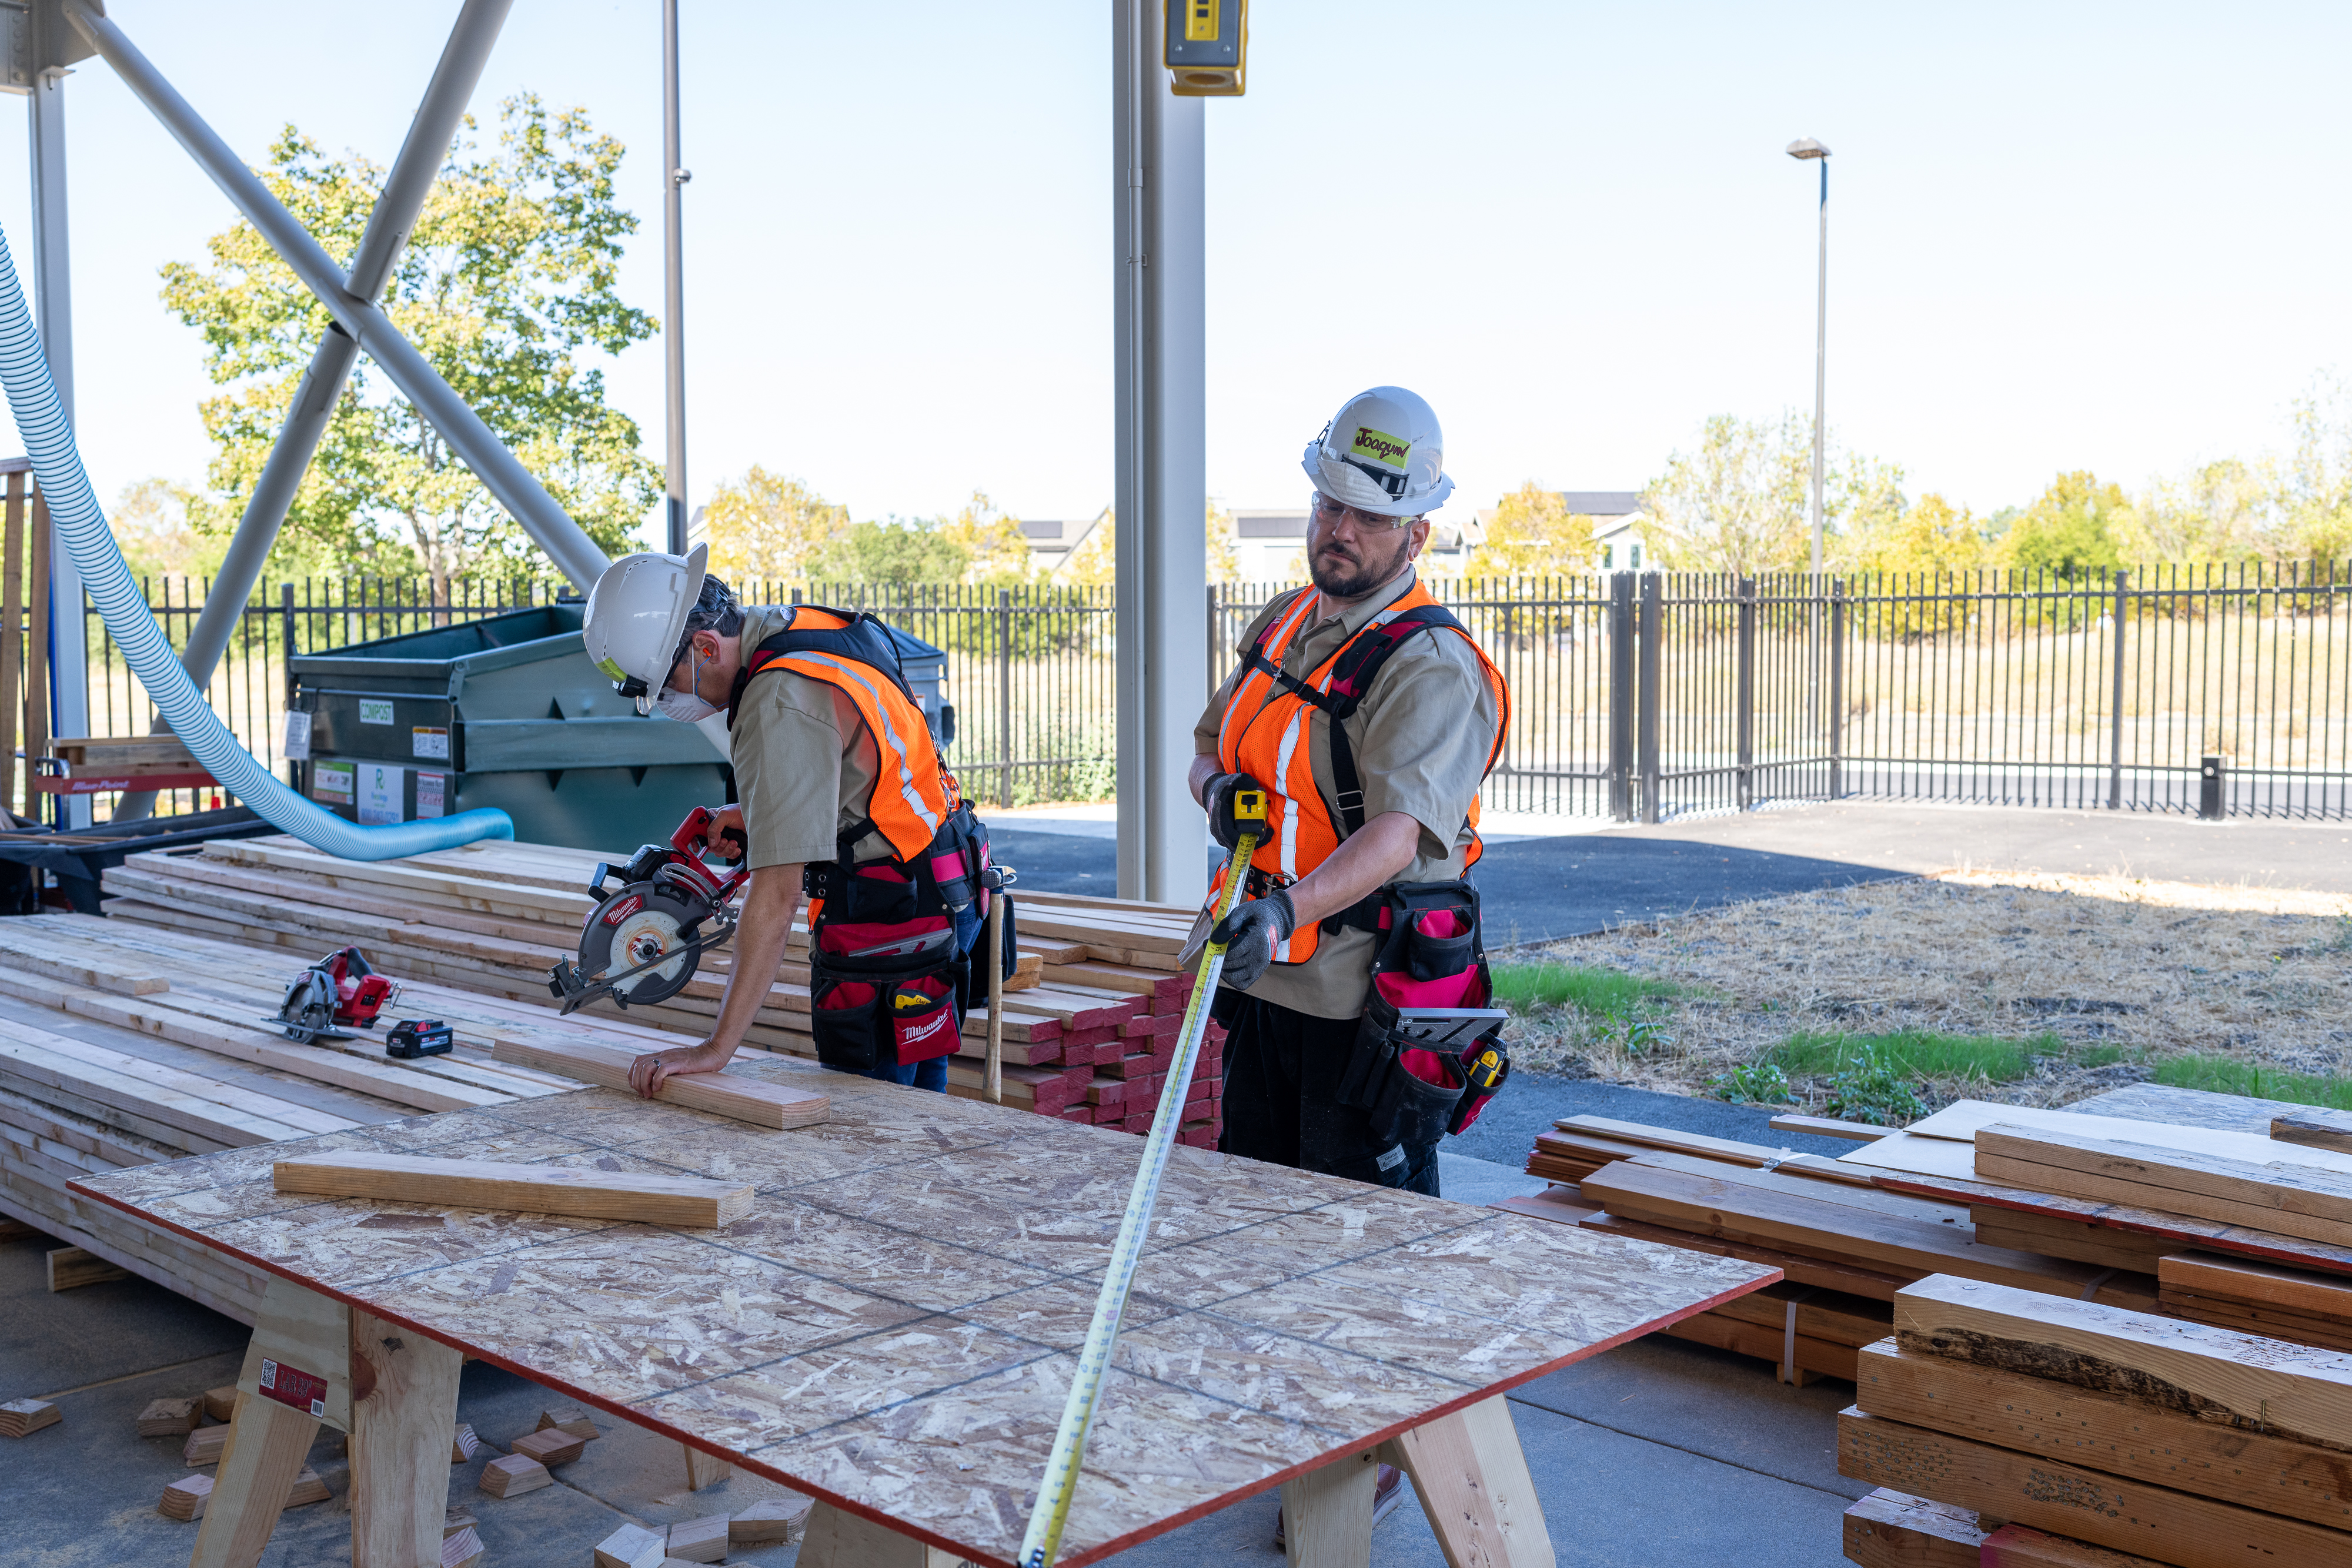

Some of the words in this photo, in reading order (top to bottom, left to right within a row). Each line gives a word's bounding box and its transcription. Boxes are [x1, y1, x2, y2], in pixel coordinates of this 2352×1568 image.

[360, 703, 391, 721] COMPOST
[607, 897, 637, 922] Milwaukee
[627, 907, 639, 915] FUEL
[902, 1009, 948, 1039] Milwaukee
[1384, 1152, 1398, 1161] UNION
[279, 1370, 296, 1393] LAR
